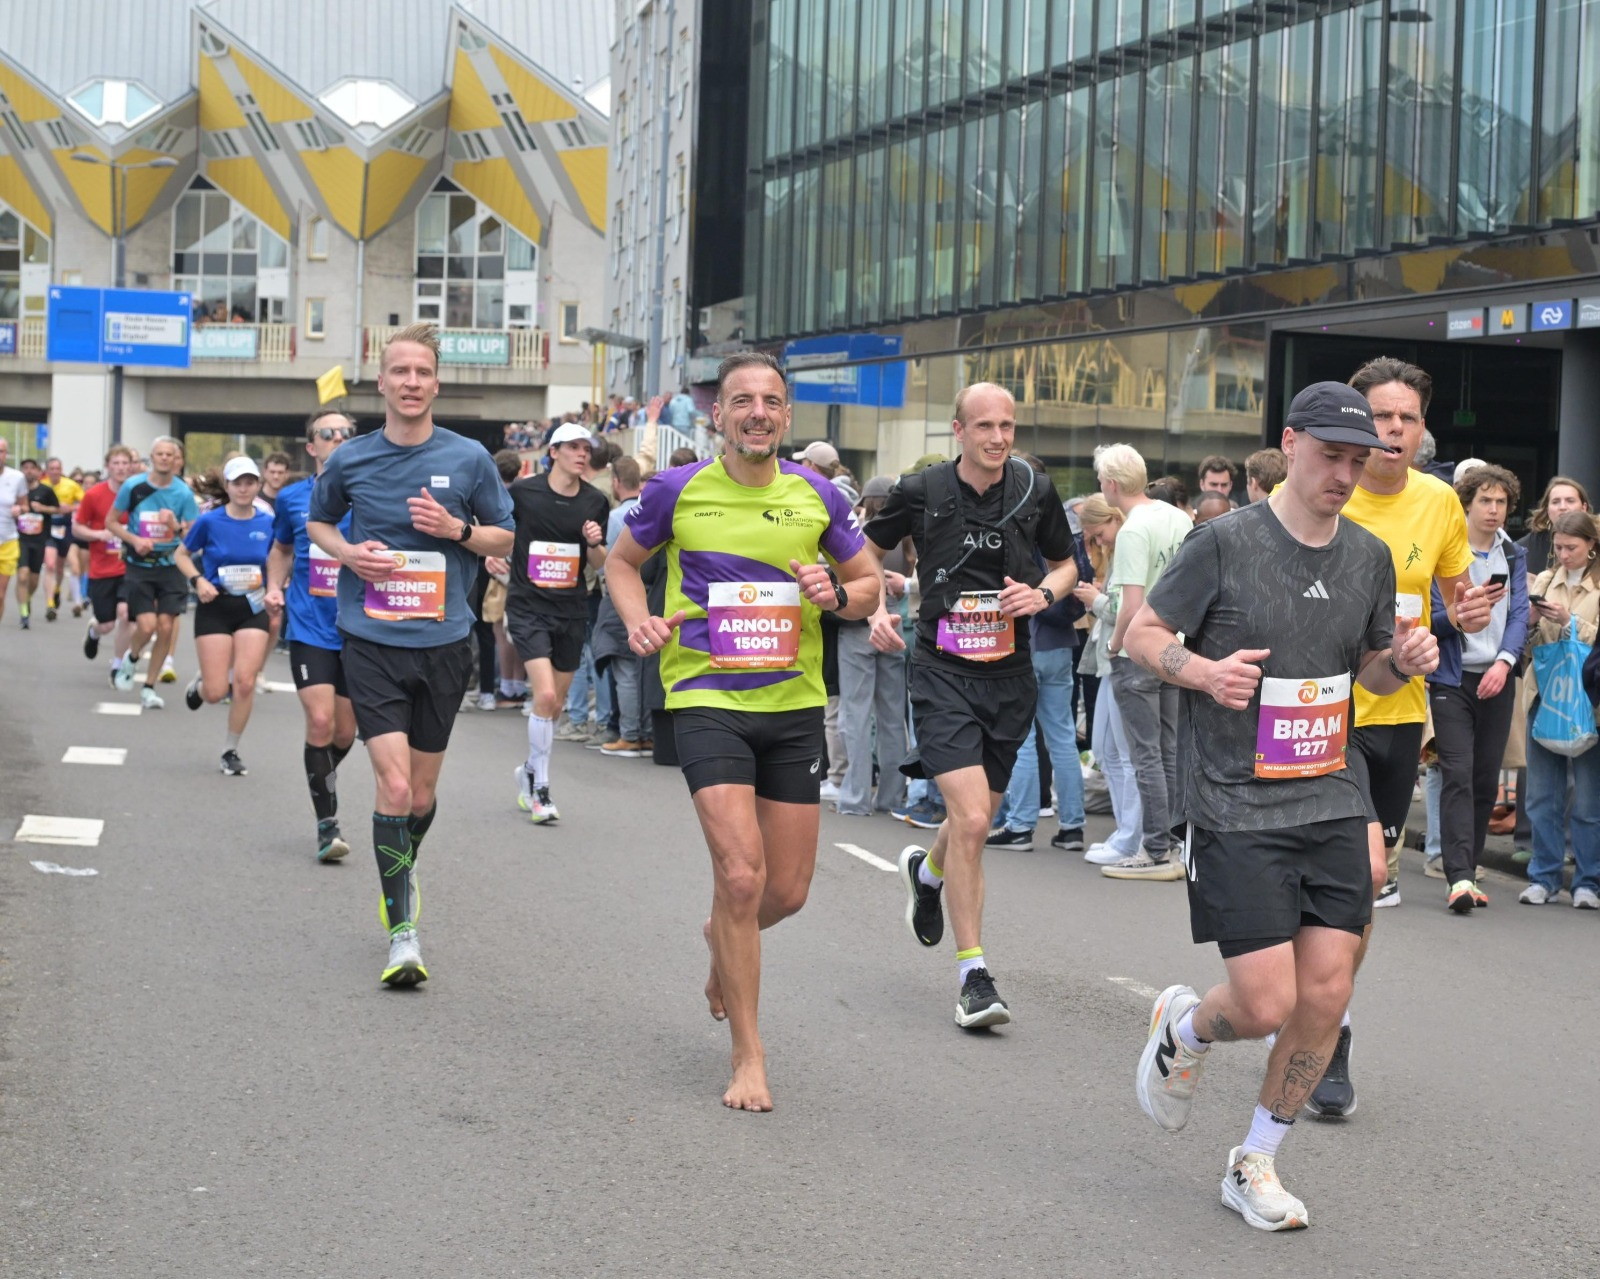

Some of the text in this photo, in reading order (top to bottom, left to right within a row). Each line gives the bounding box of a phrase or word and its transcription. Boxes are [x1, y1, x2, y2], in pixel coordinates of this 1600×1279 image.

[457, 338, 477, 353] ON
[480, 338, 505, 354] UP!
[1341, 406, 1367, 418] KIPRUN
[536, 560, 572, 572] JOEK
[372, 580, 437, 593] WERNER
[387, 595, 421, 607] 3336
[717, 618, 793, 633] ARNOLD
[733, 636, 778, 650] 15061
[957, 636, 997, 649] 12396
[1321, 686, 1334, 695] NN
[1273, 713, 1342, 739] BRAM
[1293, 740, 1328, 756] 1277
